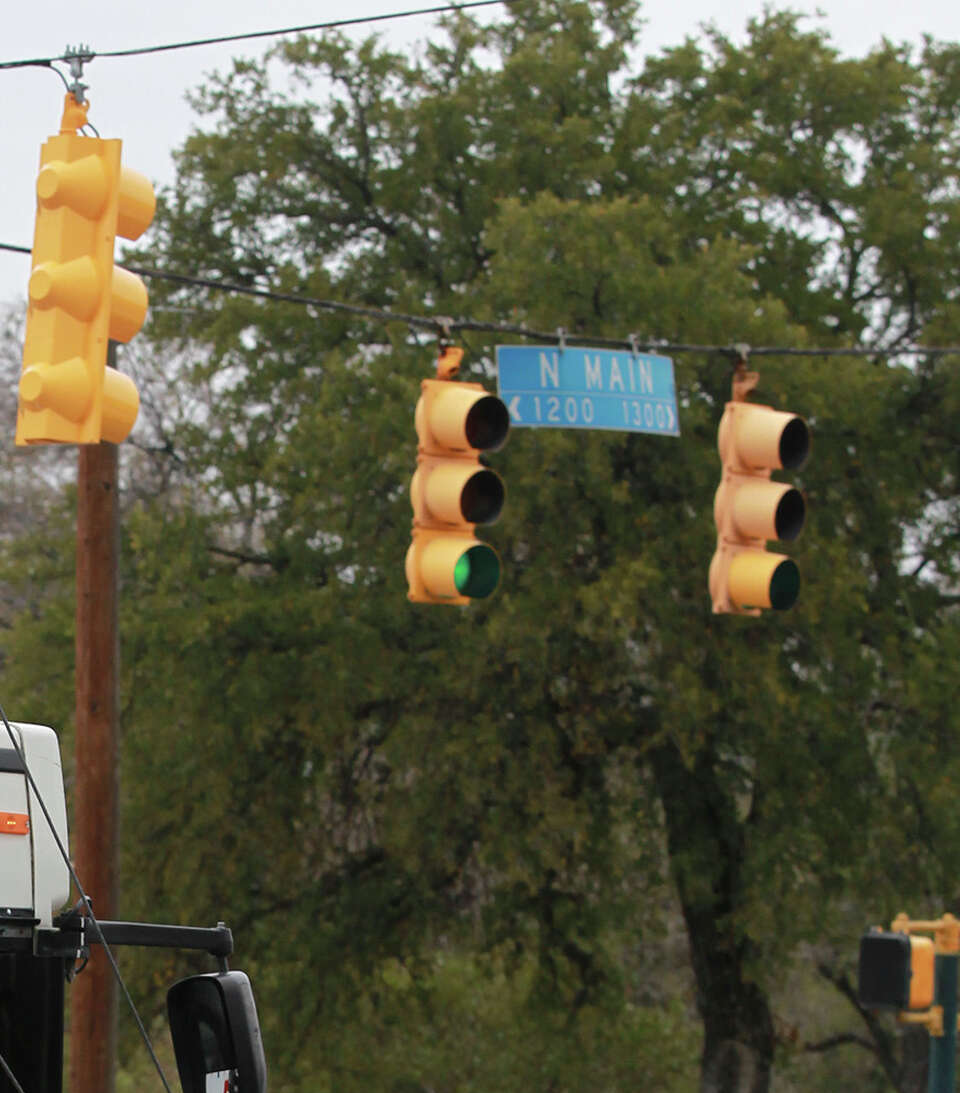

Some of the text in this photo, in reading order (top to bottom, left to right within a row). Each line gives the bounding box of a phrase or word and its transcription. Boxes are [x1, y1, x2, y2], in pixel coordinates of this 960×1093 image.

[540, 352, 654, 394] N MAIN
[534, 396, 666, 429] 1200 1300
